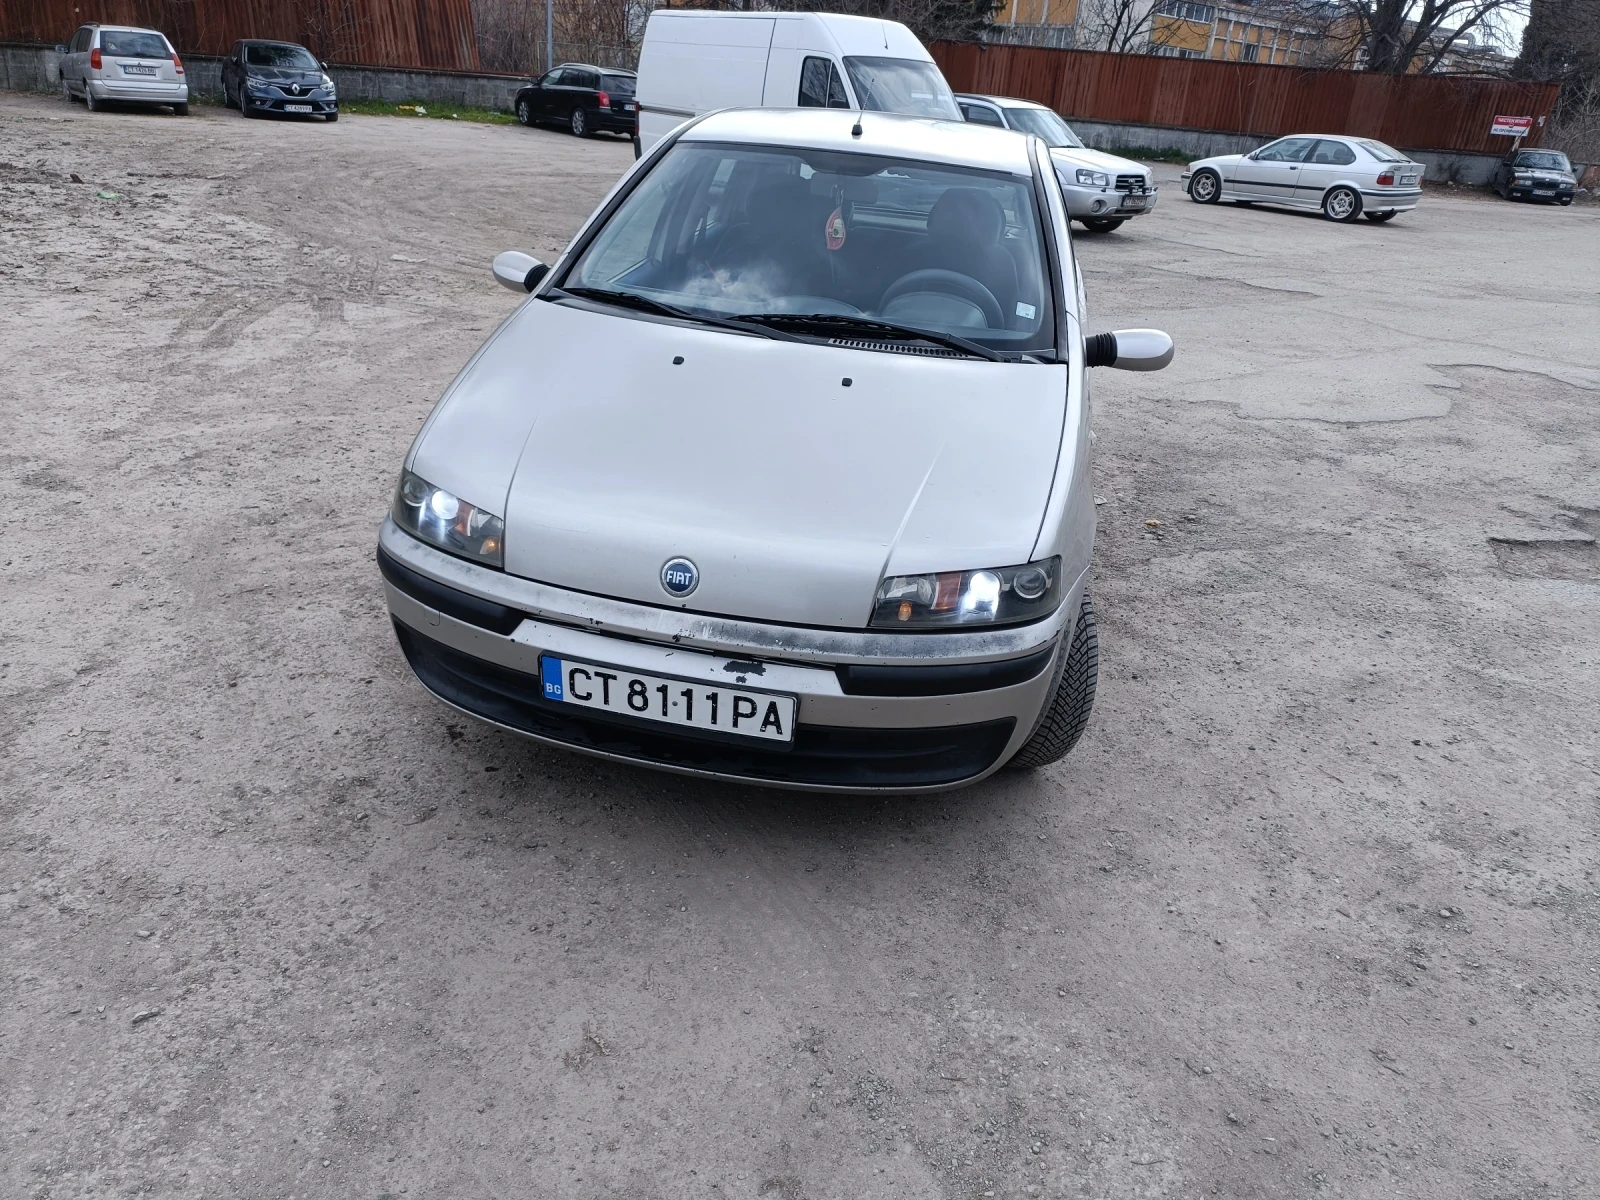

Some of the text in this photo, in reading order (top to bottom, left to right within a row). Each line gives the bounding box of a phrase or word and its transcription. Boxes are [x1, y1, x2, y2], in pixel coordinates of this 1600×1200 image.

[666, 570, 692, 585] FIAT
[546, 683, 562, 695] BG
[627, 679, 719, 725] 8111
